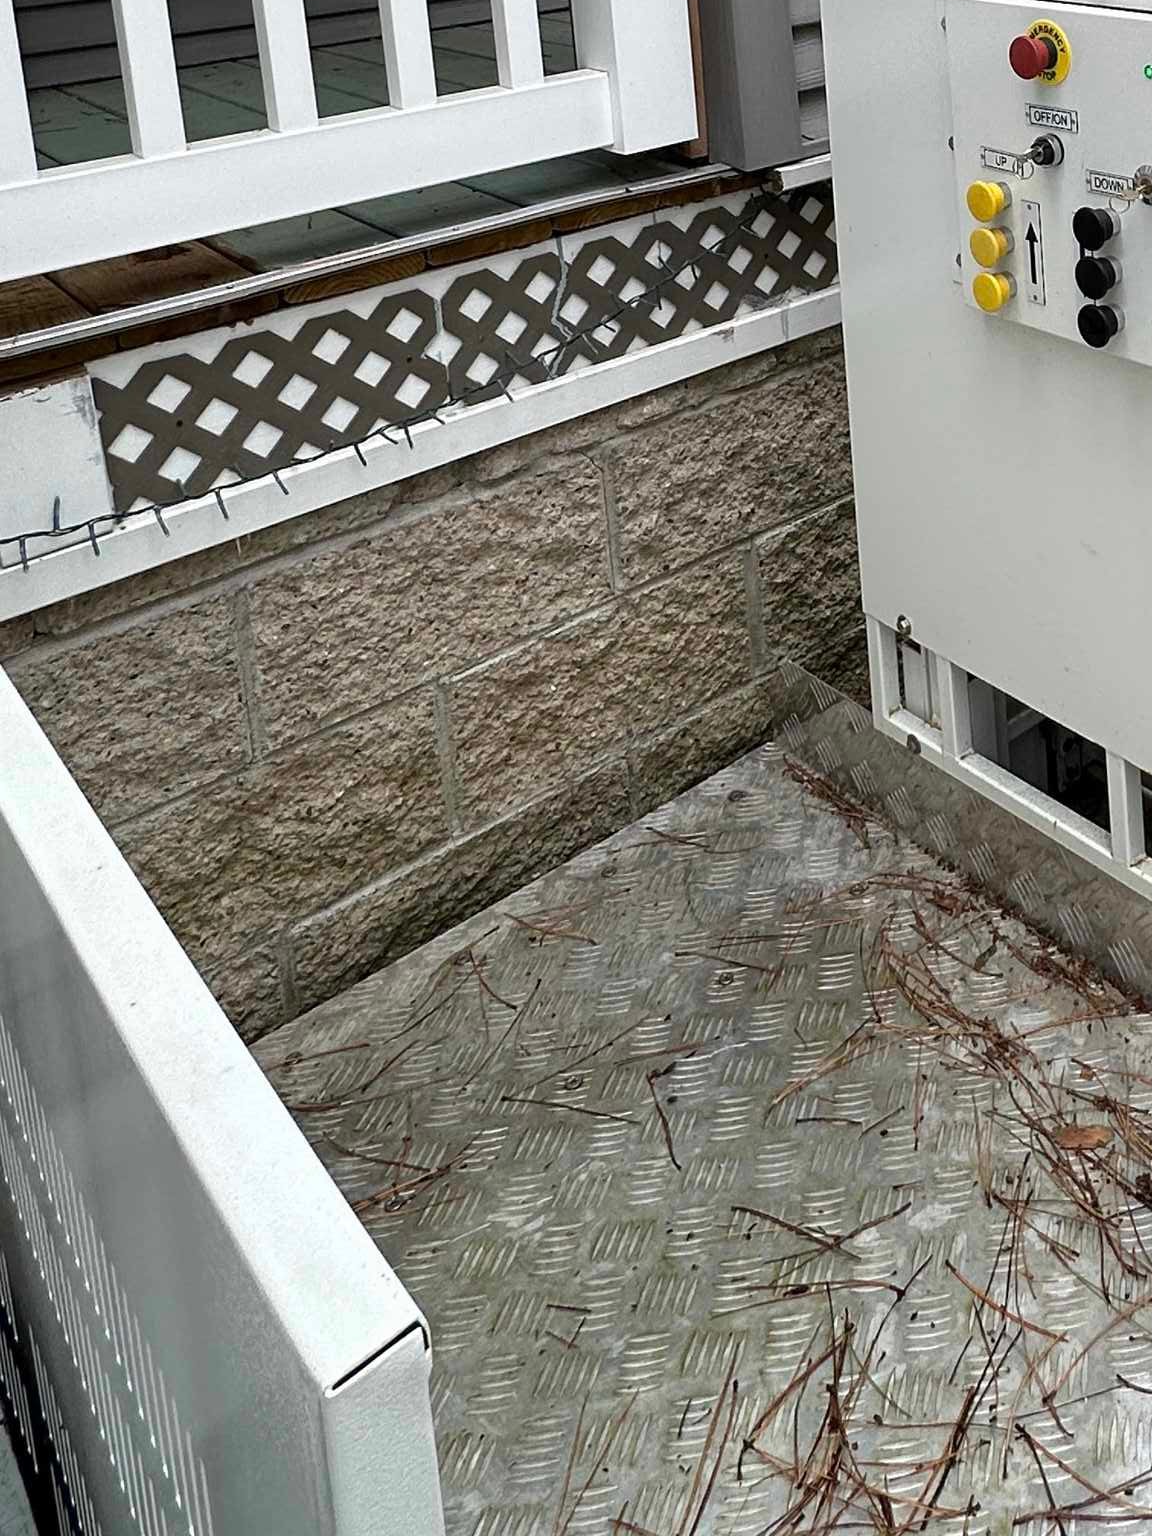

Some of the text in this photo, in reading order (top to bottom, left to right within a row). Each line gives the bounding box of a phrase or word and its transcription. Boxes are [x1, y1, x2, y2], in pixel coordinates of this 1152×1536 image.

[1028, 25, 1067, 54] MERGENCY
[1033, 110, 1068, 126] OFF/ON
[995, 155, 1007, 167] UP
[1094, 176, 1124, 192] DOWN
